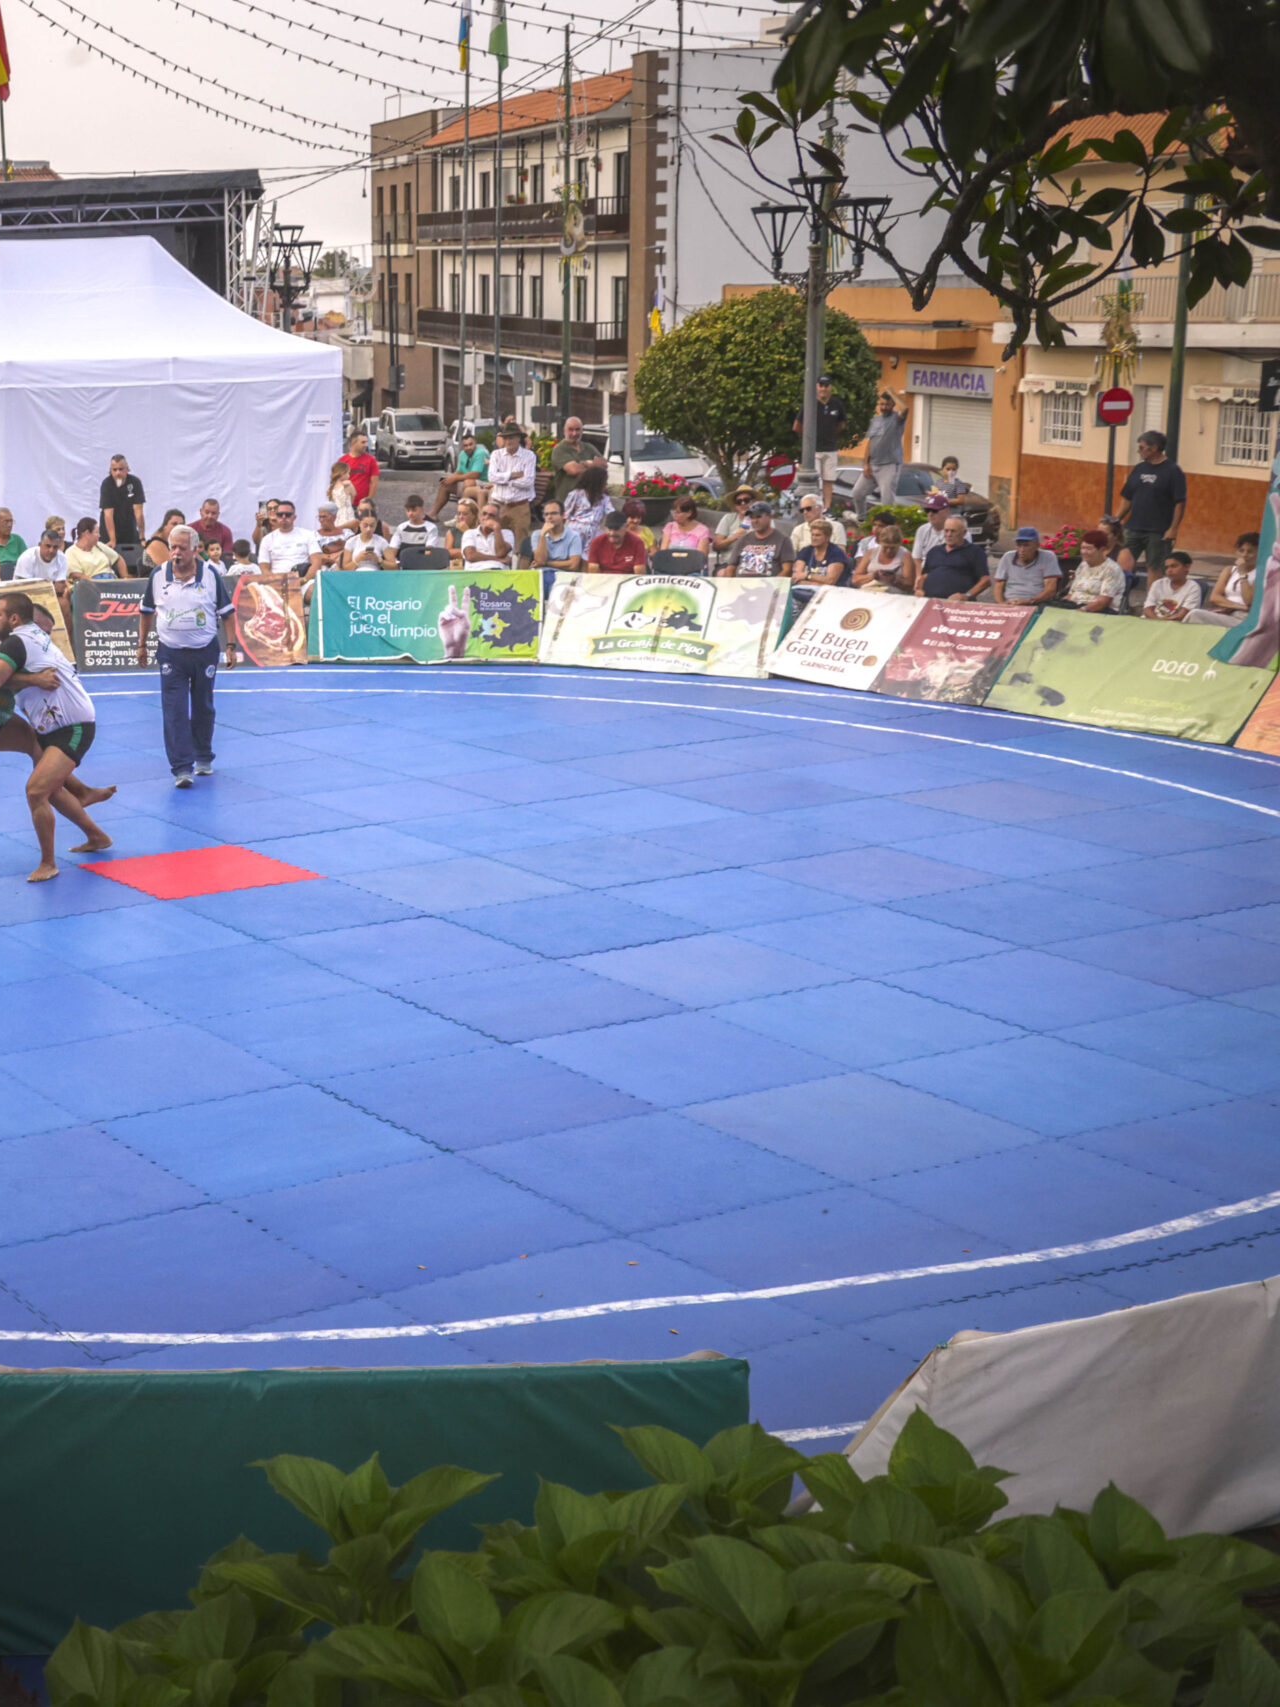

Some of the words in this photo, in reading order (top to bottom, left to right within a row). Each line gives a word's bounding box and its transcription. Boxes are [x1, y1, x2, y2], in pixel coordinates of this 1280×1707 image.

[913, 369, 986, 392] FARMACIA
[635, 574, 701, 590] Carnicería
[347, 596, 360, 610] El
[365, 596, 422, 611] Rosario
[480, 600, 513, 609] Rosario
[377, 610, 391, 624] el
[84, 629, 124, 638] Carretera
[126, 630, 138, 638] La
[390, 624, 438, 640] limpio
[798, 628, 819, 642] El
[821, 632, 869, 651] Buen
[85, 639, 97, 647] La
[99, 639, 131, 648] Laguna
[598, 639, 614, 650] La
[617, 637, 657, 650] Granja
[659, 638, 676, 649] de
[677, 641, 706, 656] Pipo
[96, 658, 112, 666] 922
[115, 658, 125, 666] 31
